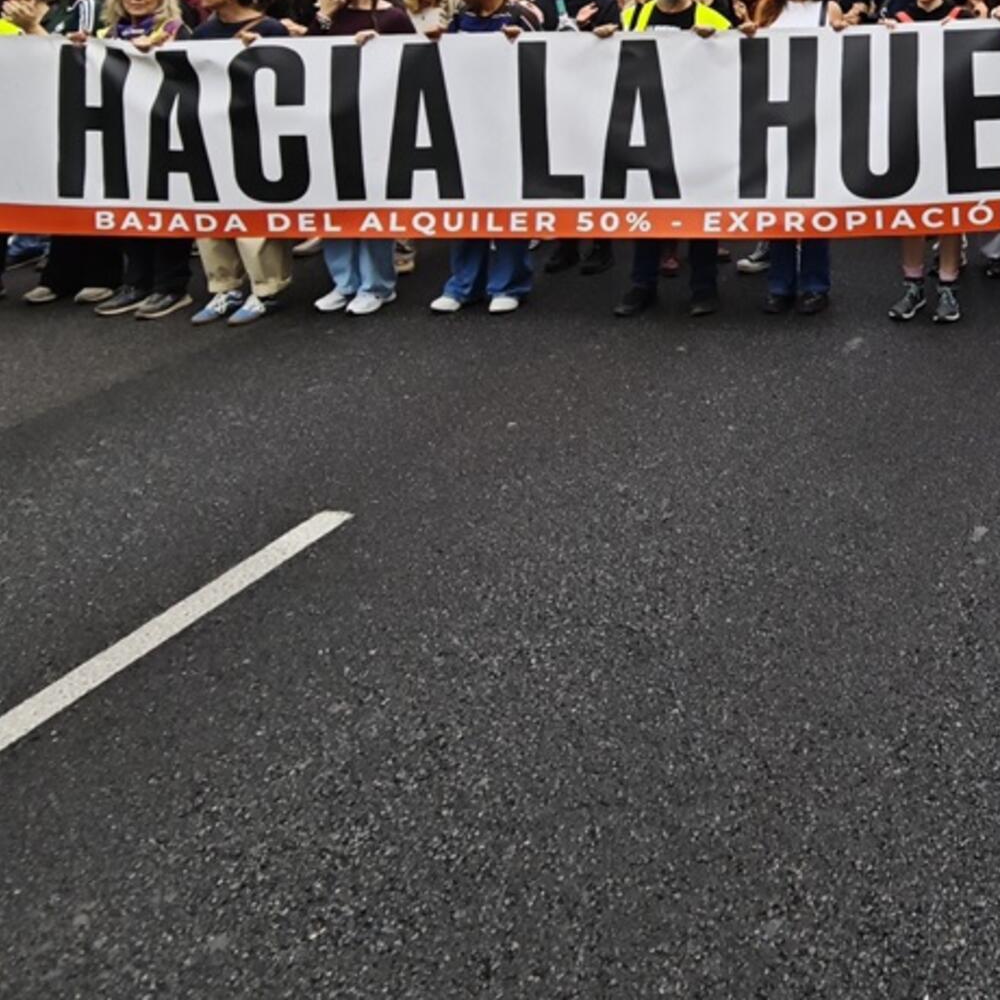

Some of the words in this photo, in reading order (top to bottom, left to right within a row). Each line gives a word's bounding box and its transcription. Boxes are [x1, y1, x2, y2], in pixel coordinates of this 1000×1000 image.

[57, 41, 465, 203] HACIA
[517, 39, 682, 200] LA
[95, 210, 247, 232] BAJADA
[267, 213, 341, 233] DEL
[359, 211, 556, 237] ALQUILER
[576, 211, 652, 233] 50%
